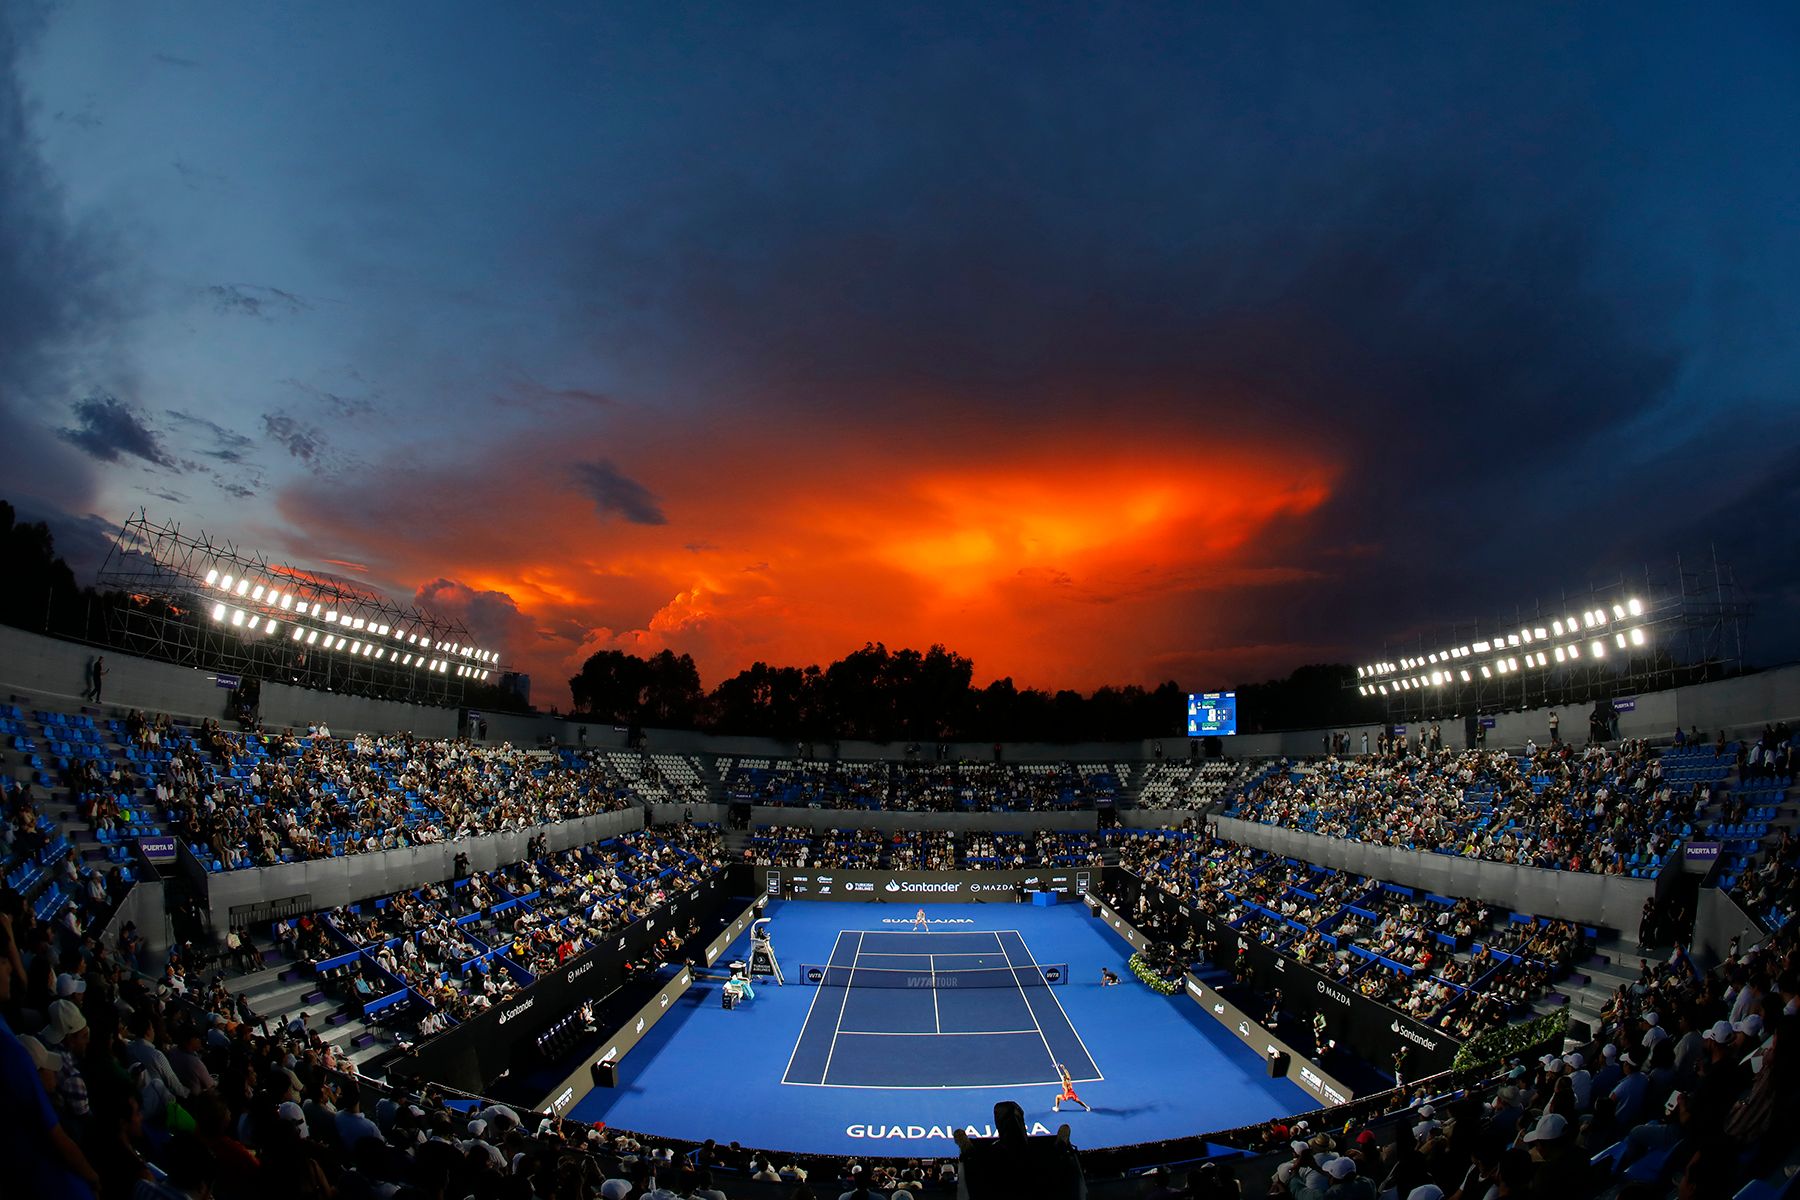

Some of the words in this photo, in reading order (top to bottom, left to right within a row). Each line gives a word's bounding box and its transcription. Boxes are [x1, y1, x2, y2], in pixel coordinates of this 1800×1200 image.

[901, 881, 960, 892] Santander
[982, 884, 1015, 892] MAZDA
[574, 960, 594, 978] MAZDA
[907, 977, 933, 988] WTA
[936, 977, 958, 988] TOUR
[1325, 986, 1351, 1007] MAZDA
[506, 998, 534, 1021] Santander
[1399, 1025, 1436, 1052] Santander
[846, 1122, 1051, 1139] GUADALAJA
